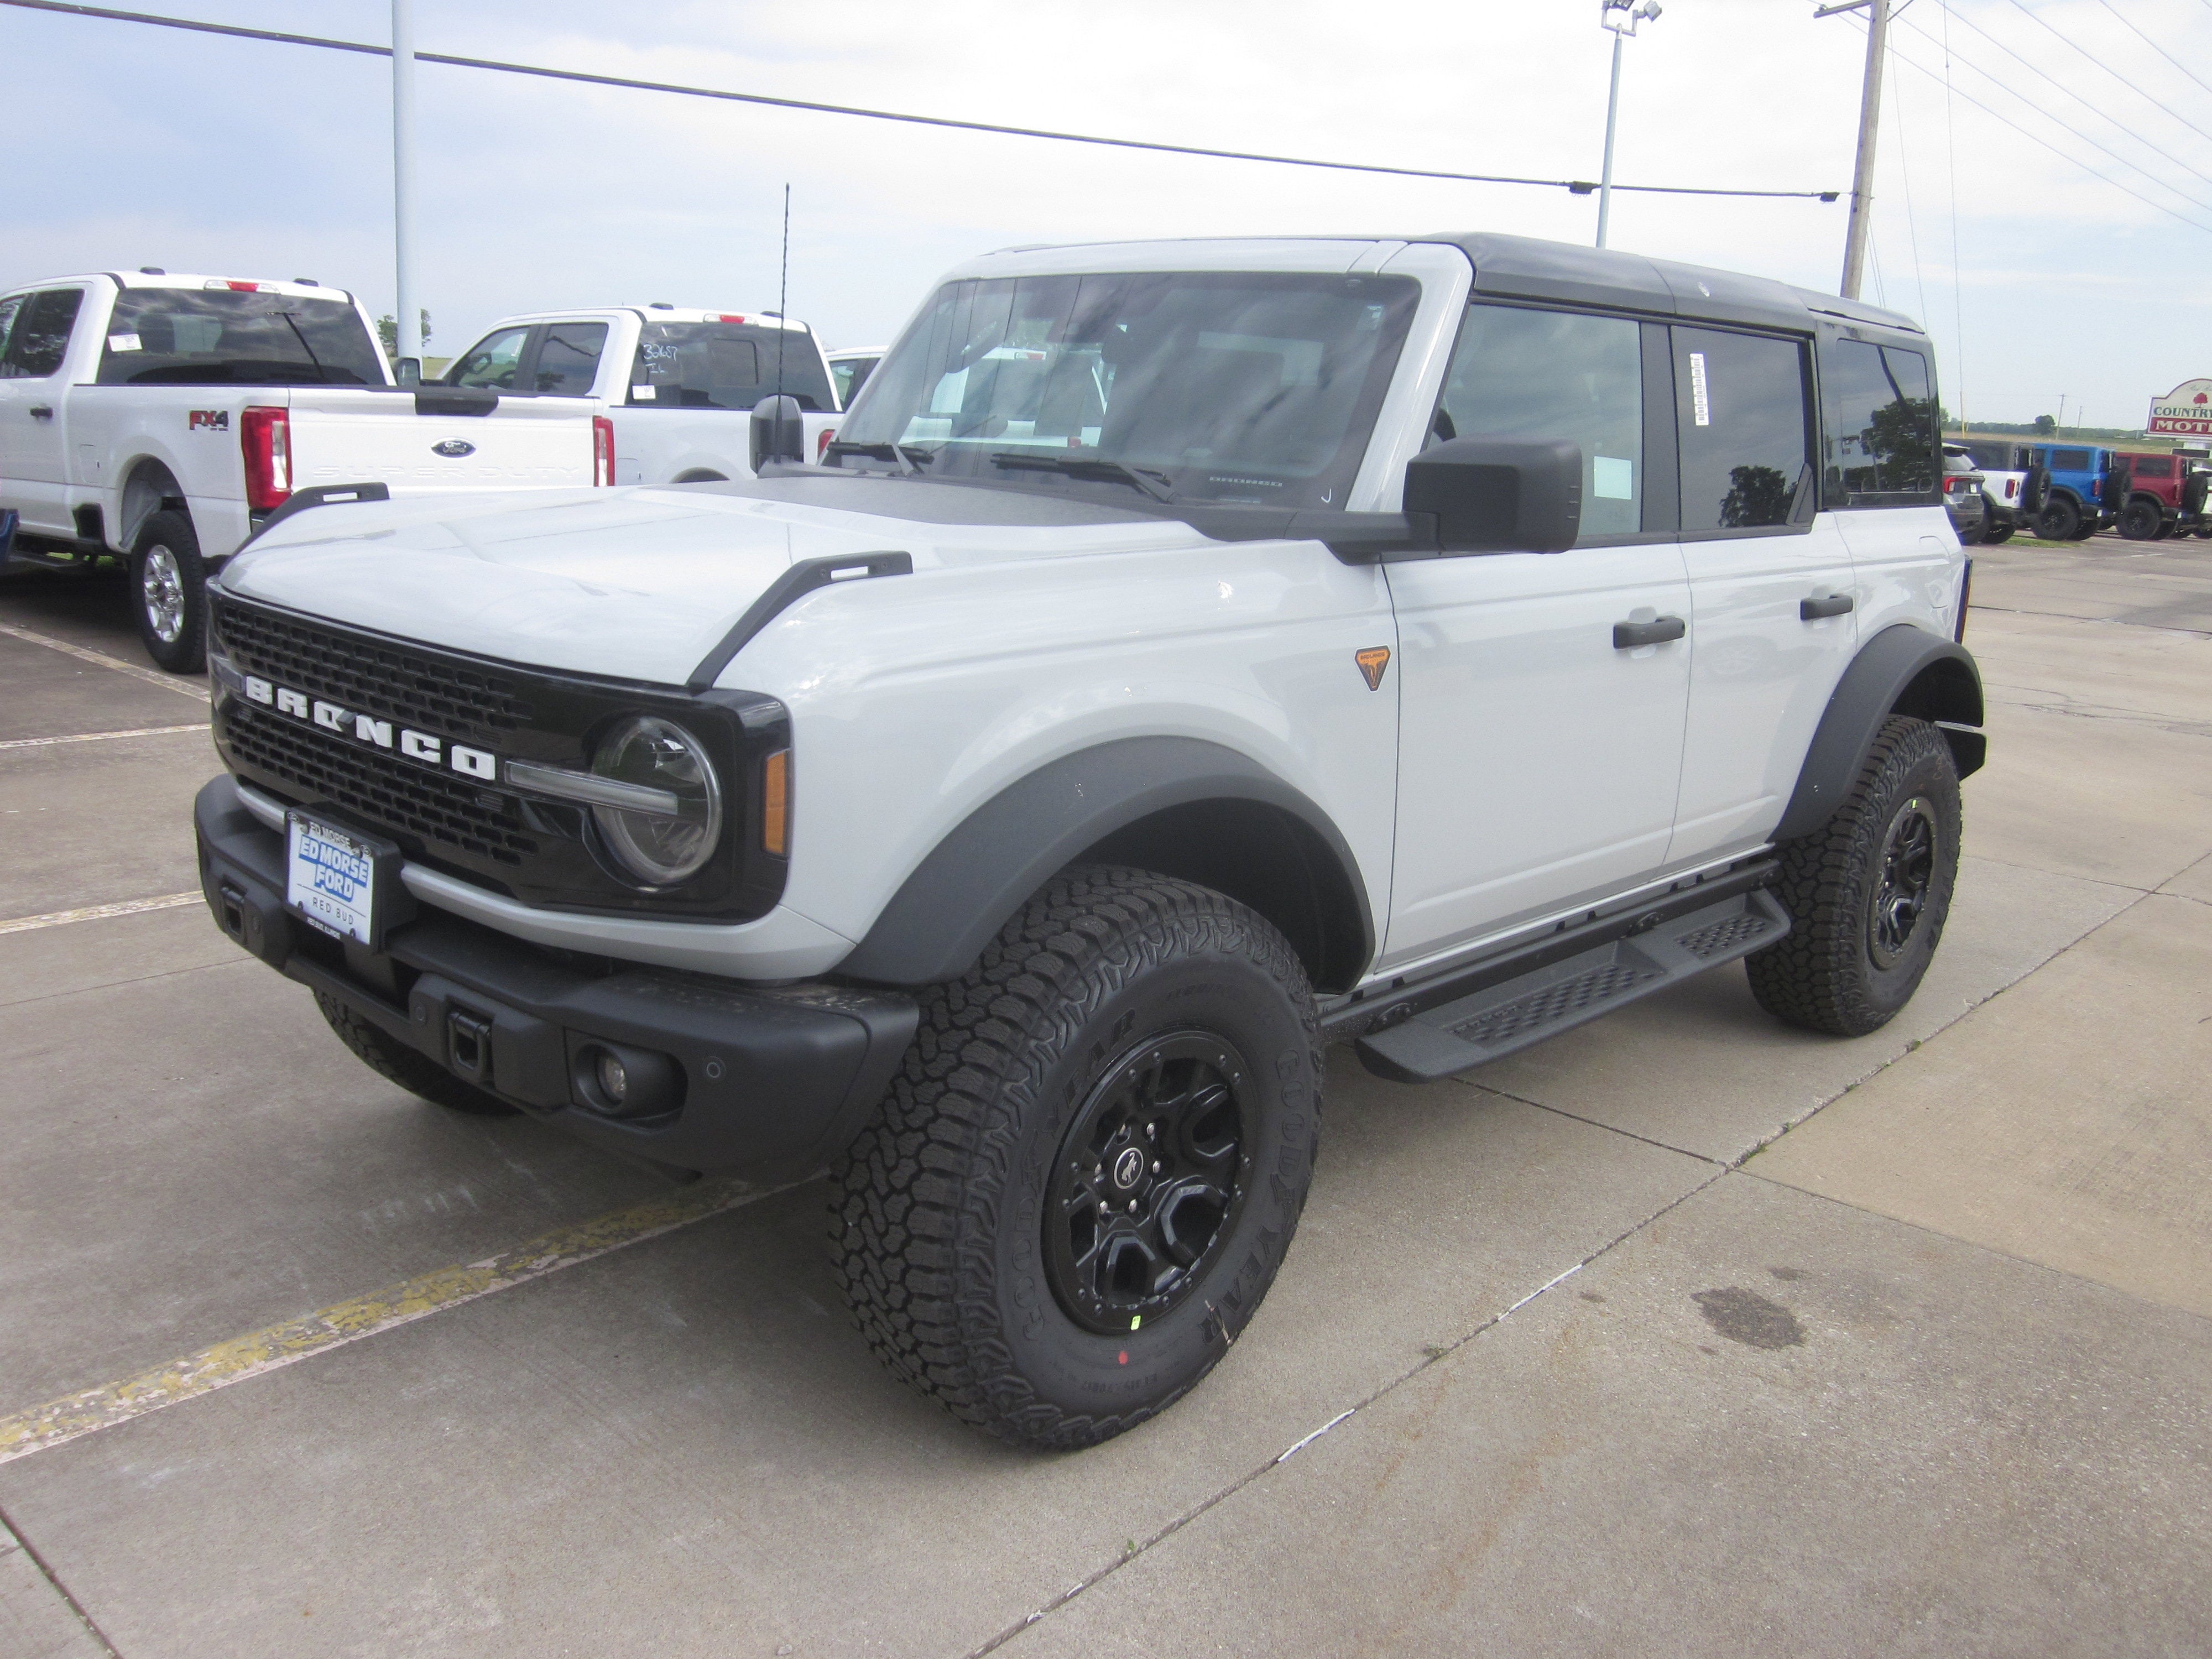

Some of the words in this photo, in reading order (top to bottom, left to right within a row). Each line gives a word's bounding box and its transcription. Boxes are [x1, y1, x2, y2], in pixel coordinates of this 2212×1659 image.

[189, 410, 228, 430] FX4
[443, 442, 467, 453] Ford
[314, 466, 466, 478] SUPER
[479, 466, 580, 478] DUTY
[246, 675, 495, 781] BRONCO
[300, 836, 319, 860] ED
[319, 842, 369, 885] MORSE
[315, 863, 353, 900] FORD
[312, 896, 331, 914] RED
[336, 907, 354, 925] BUD
